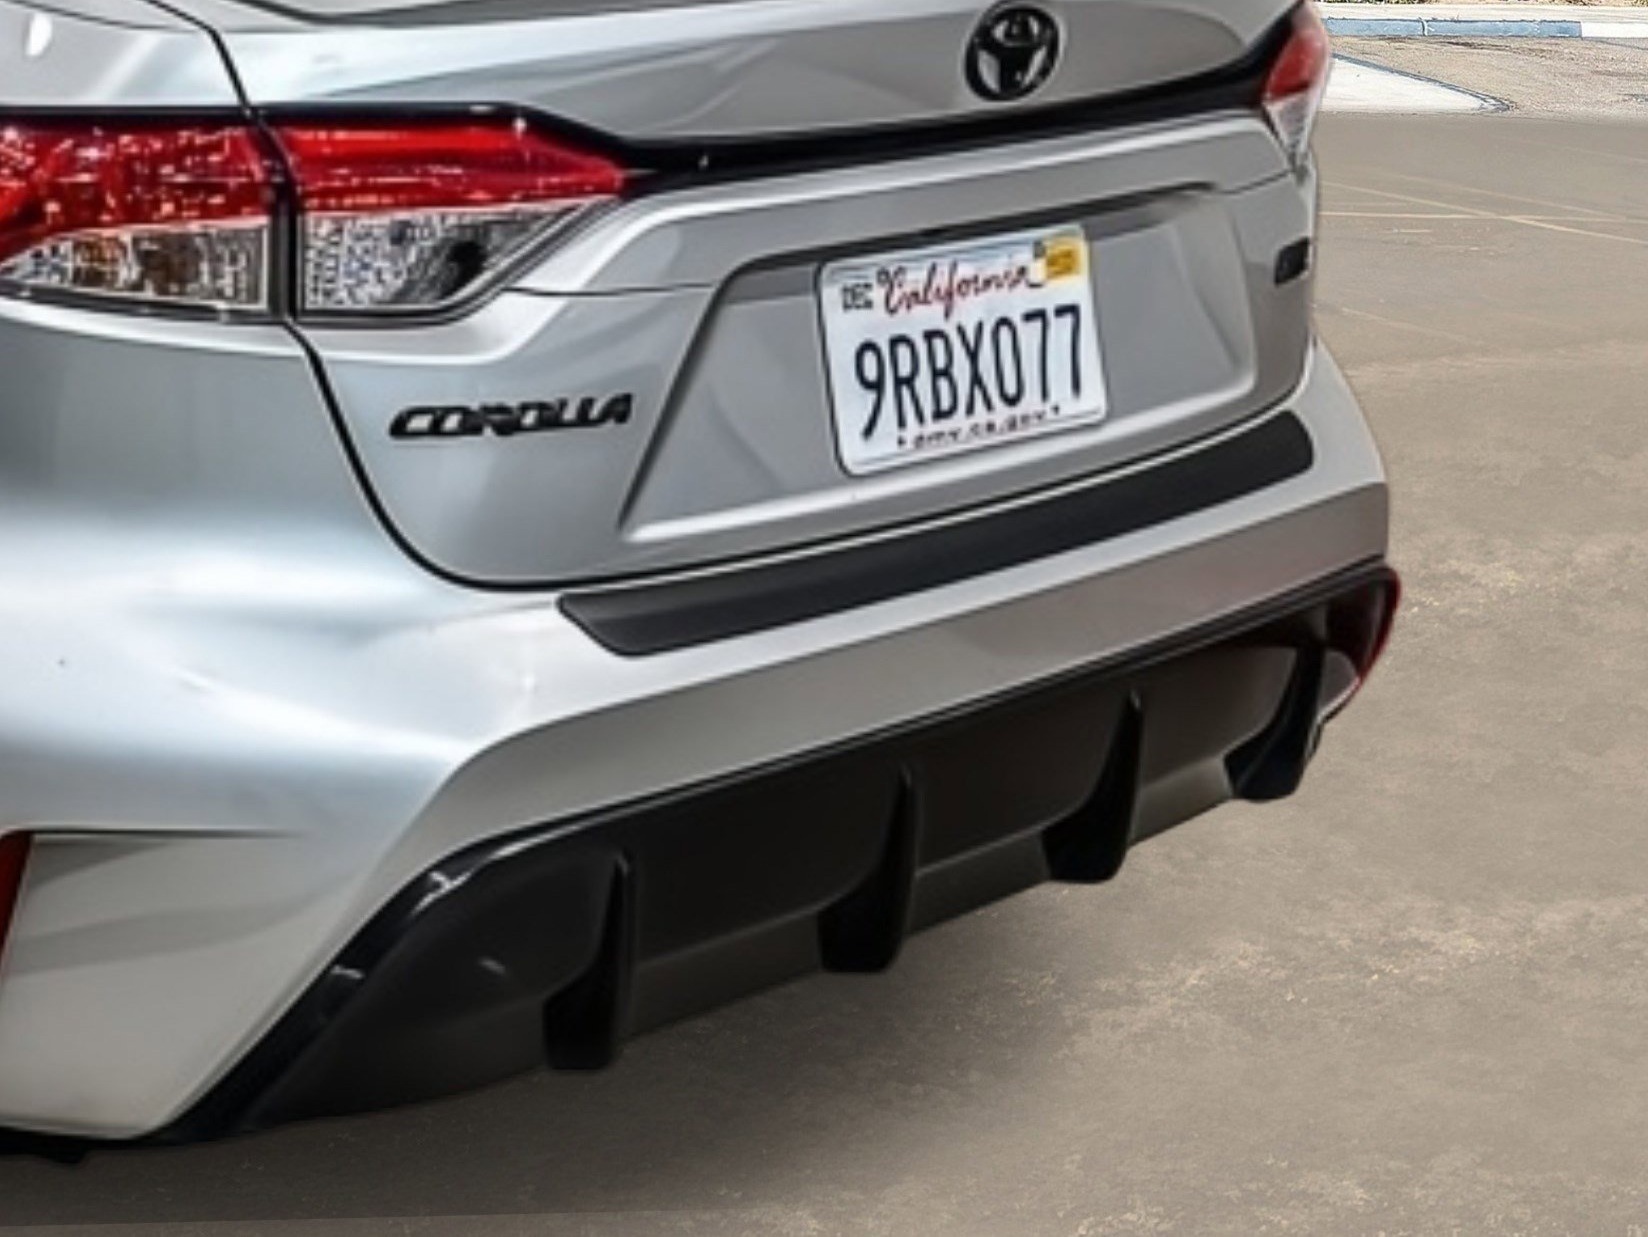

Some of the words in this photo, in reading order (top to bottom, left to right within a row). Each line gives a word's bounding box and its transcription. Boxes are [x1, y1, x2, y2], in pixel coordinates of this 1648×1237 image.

[876, 259, 1043, 320] California
[854, 302, 1082, 442] 9RBX077
[388, 392, 633, 439] COROLLA
